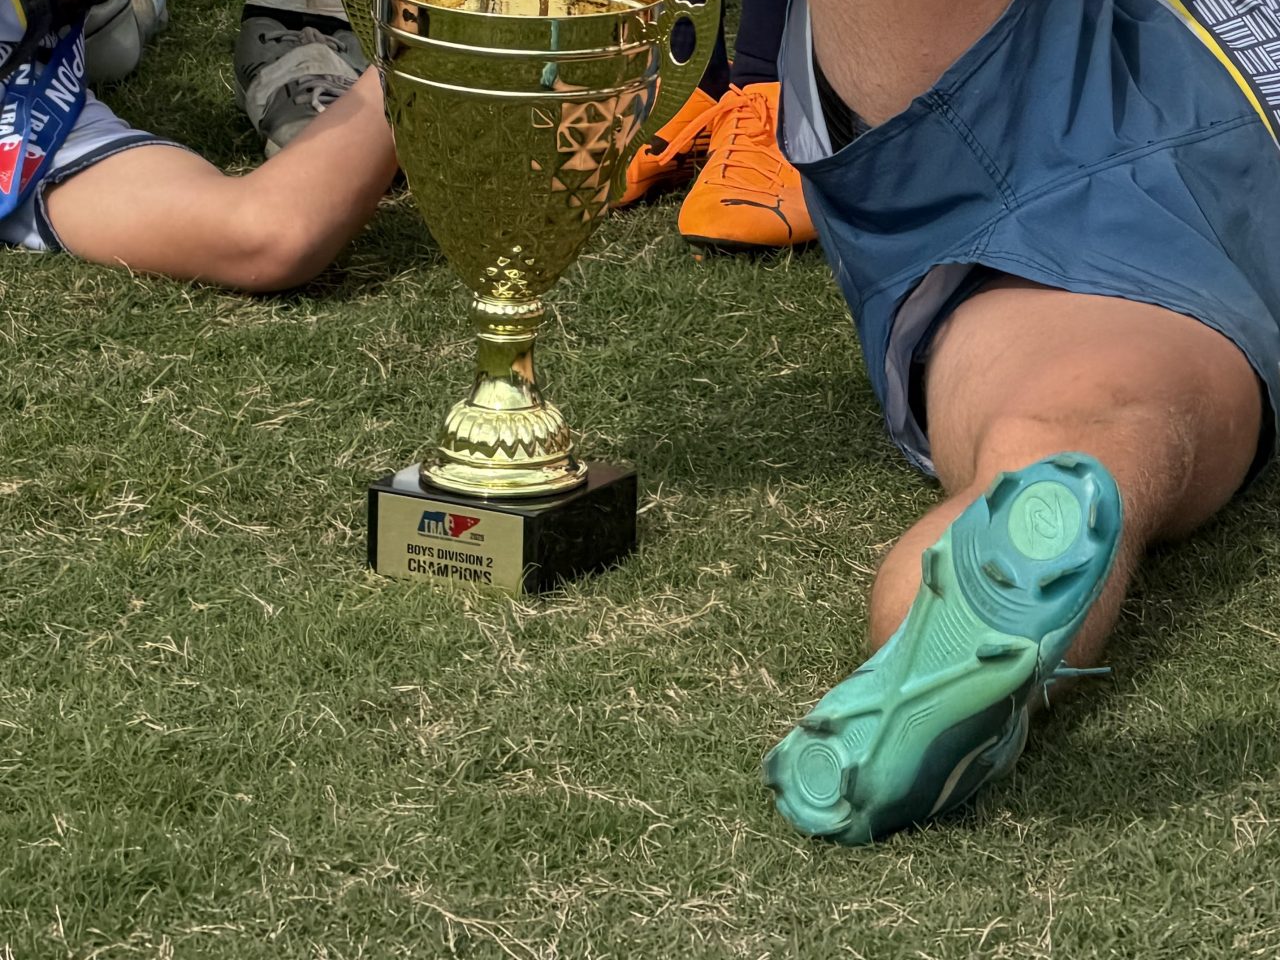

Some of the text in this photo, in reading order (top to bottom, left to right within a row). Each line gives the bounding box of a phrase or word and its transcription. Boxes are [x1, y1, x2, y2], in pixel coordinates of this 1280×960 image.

[407, 544, 494, 569] BOYS DIVISION 2
[408, 558, 492, 585] CHAMPIONS
